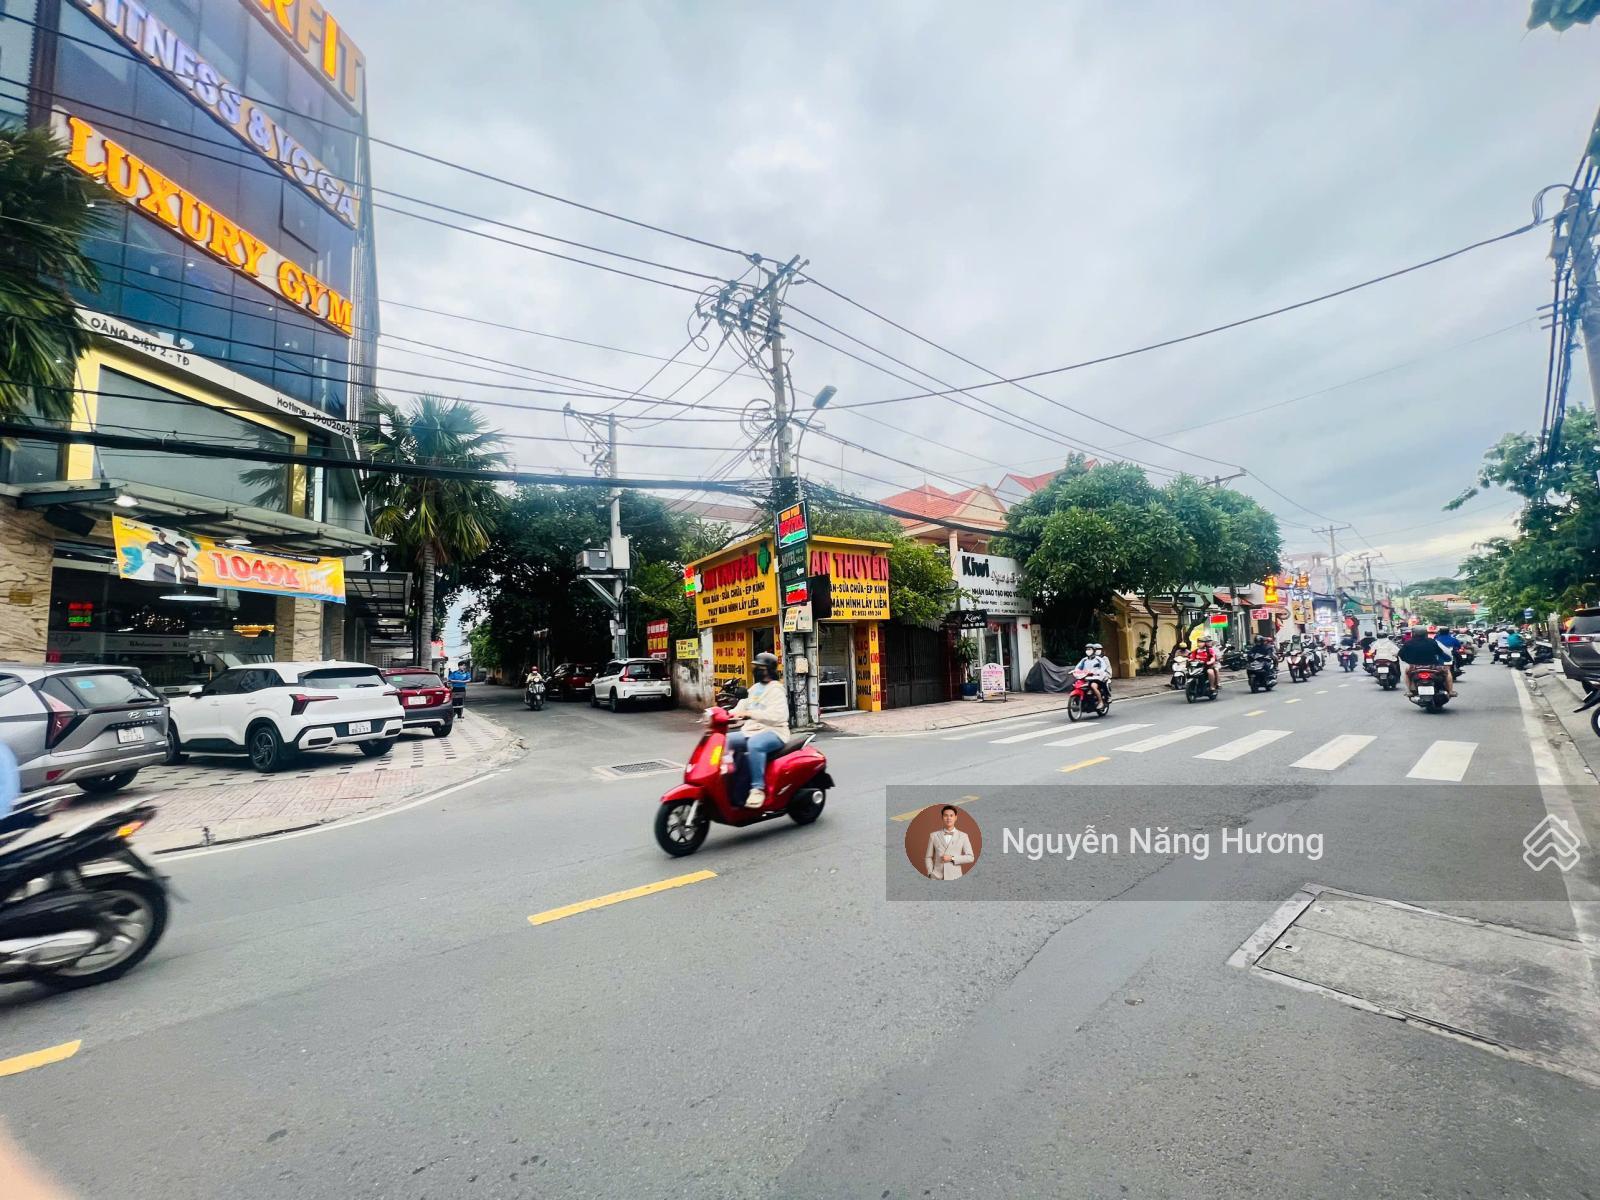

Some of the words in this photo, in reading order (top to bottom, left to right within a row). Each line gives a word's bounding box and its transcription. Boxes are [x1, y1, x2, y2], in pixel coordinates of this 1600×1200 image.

[247, 107, 271, 152] &
[65, 115, 268, 278] LUXURY
[277, 260, 353, 335] GYM
[160, 348, 167, 357] 2
[811, 550, 830, 576] AN
[961, 555, 990, 577] Kiwi
